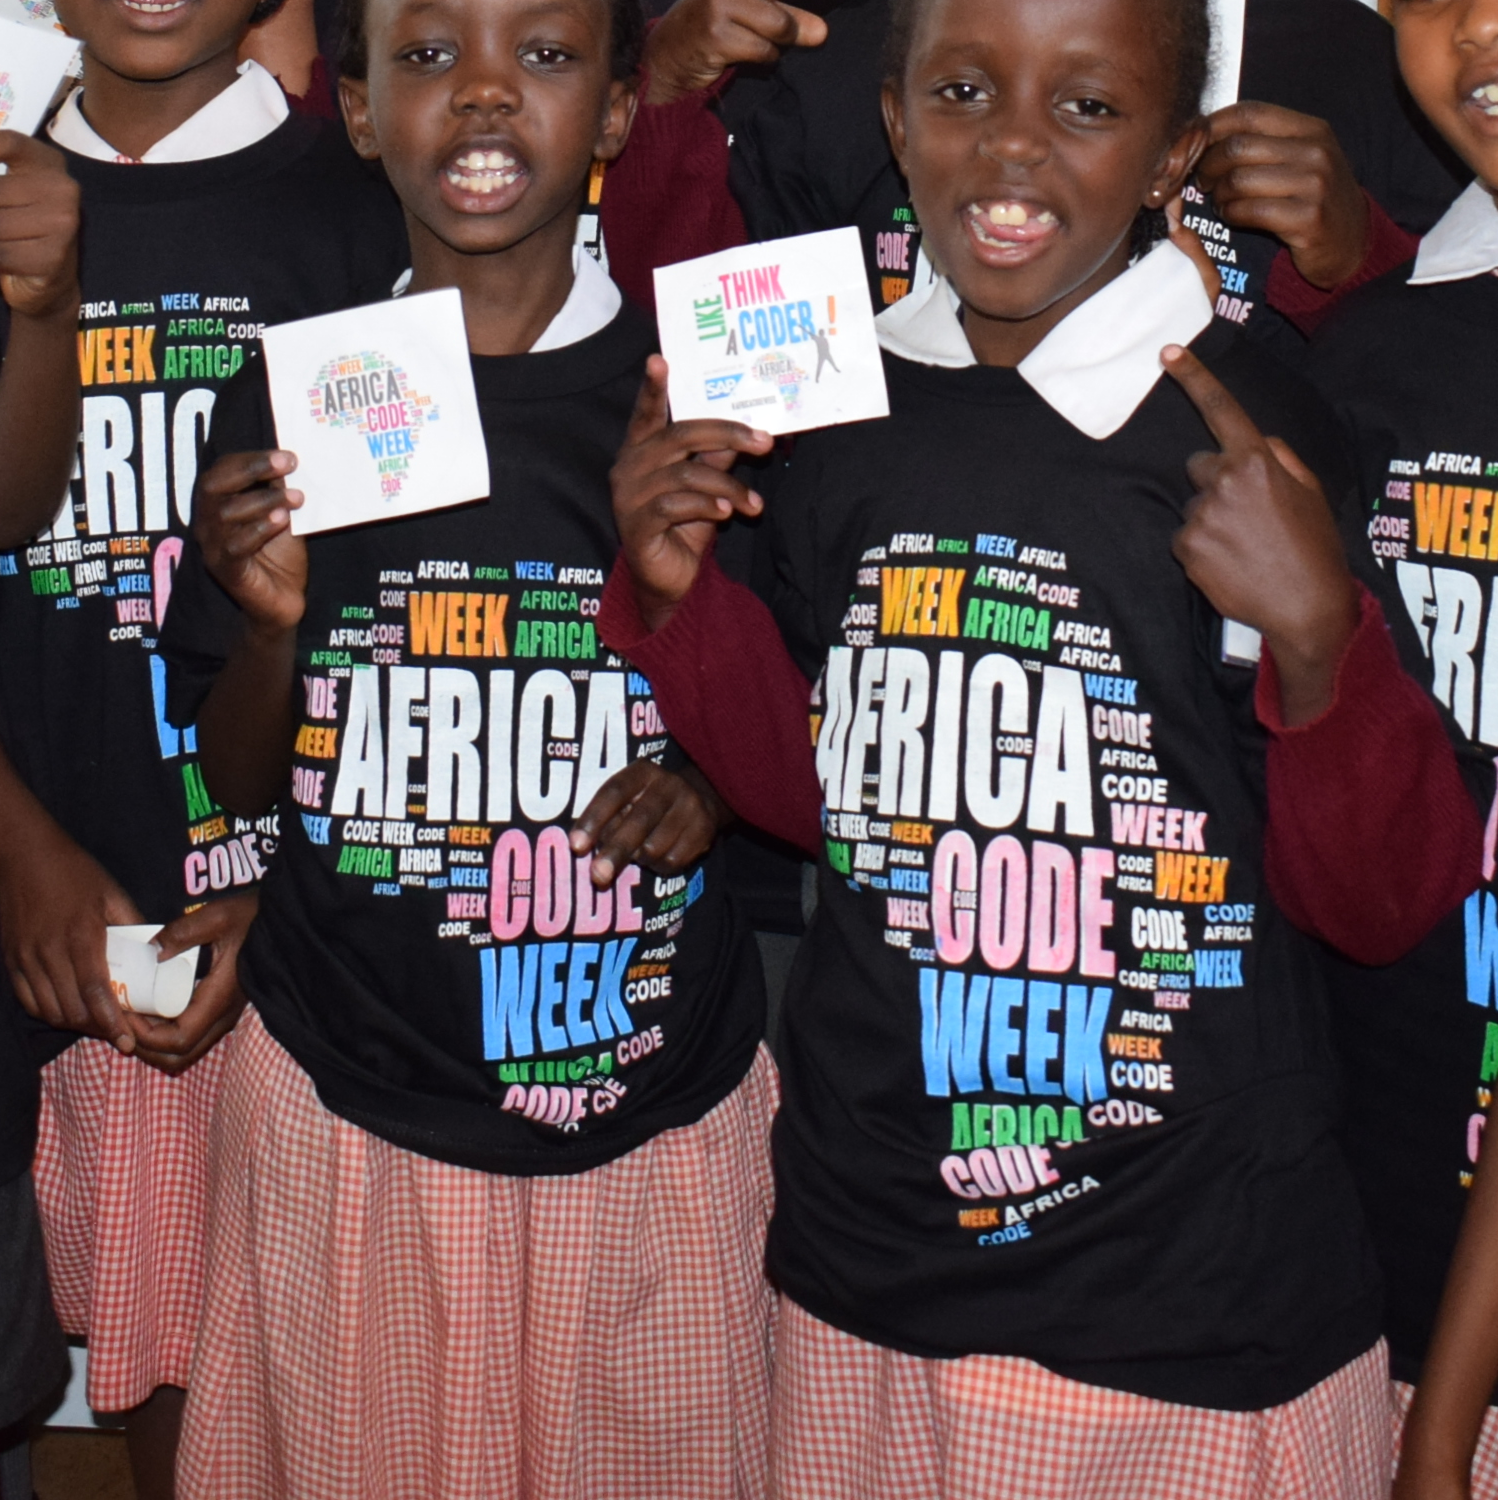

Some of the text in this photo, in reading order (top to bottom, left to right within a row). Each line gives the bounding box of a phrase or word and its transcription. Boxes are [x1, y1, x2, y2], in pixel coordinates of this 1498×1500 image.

[161, 293, 199, 311] WEEK
[719, 264, 786, 310] THINK
[693, 294, 726, 340] LIKE
[727, 300, 815, 355] A CODER
[337, 359, 363, 376] WEEK
[706, 378, 736, 400] SAP
[759, 359, 793, 376] AFRICA
[325, 369, 402, 415] AFRICA
[367, 401, 410, 432] CODE
[367, 428, 415, 459] WEEK
[378, 456, 409, 474] AFRICA
[1426, 452, 1481, 475] AFRICA
[381, 478, 402, 493] CODE
[409, 592, 509, 658] WEEK
[880, 566, 965, 638] WEEK
[963, 598, 1050, 651] AFRICA
[515, 621, 596, 660] AFRICA
[331, 664, 629, 824] AFRICA
[815, 645, 1095, 836] AFRICA
[1110, 802, 1208, 853] WEEK
[1155, 850, 1229, 903] WEEK
[932, 829, 1116, 979] CODE
[479, 938, 637, 1062] WEEK
[919, 967, 1113, 1106] WEEK
